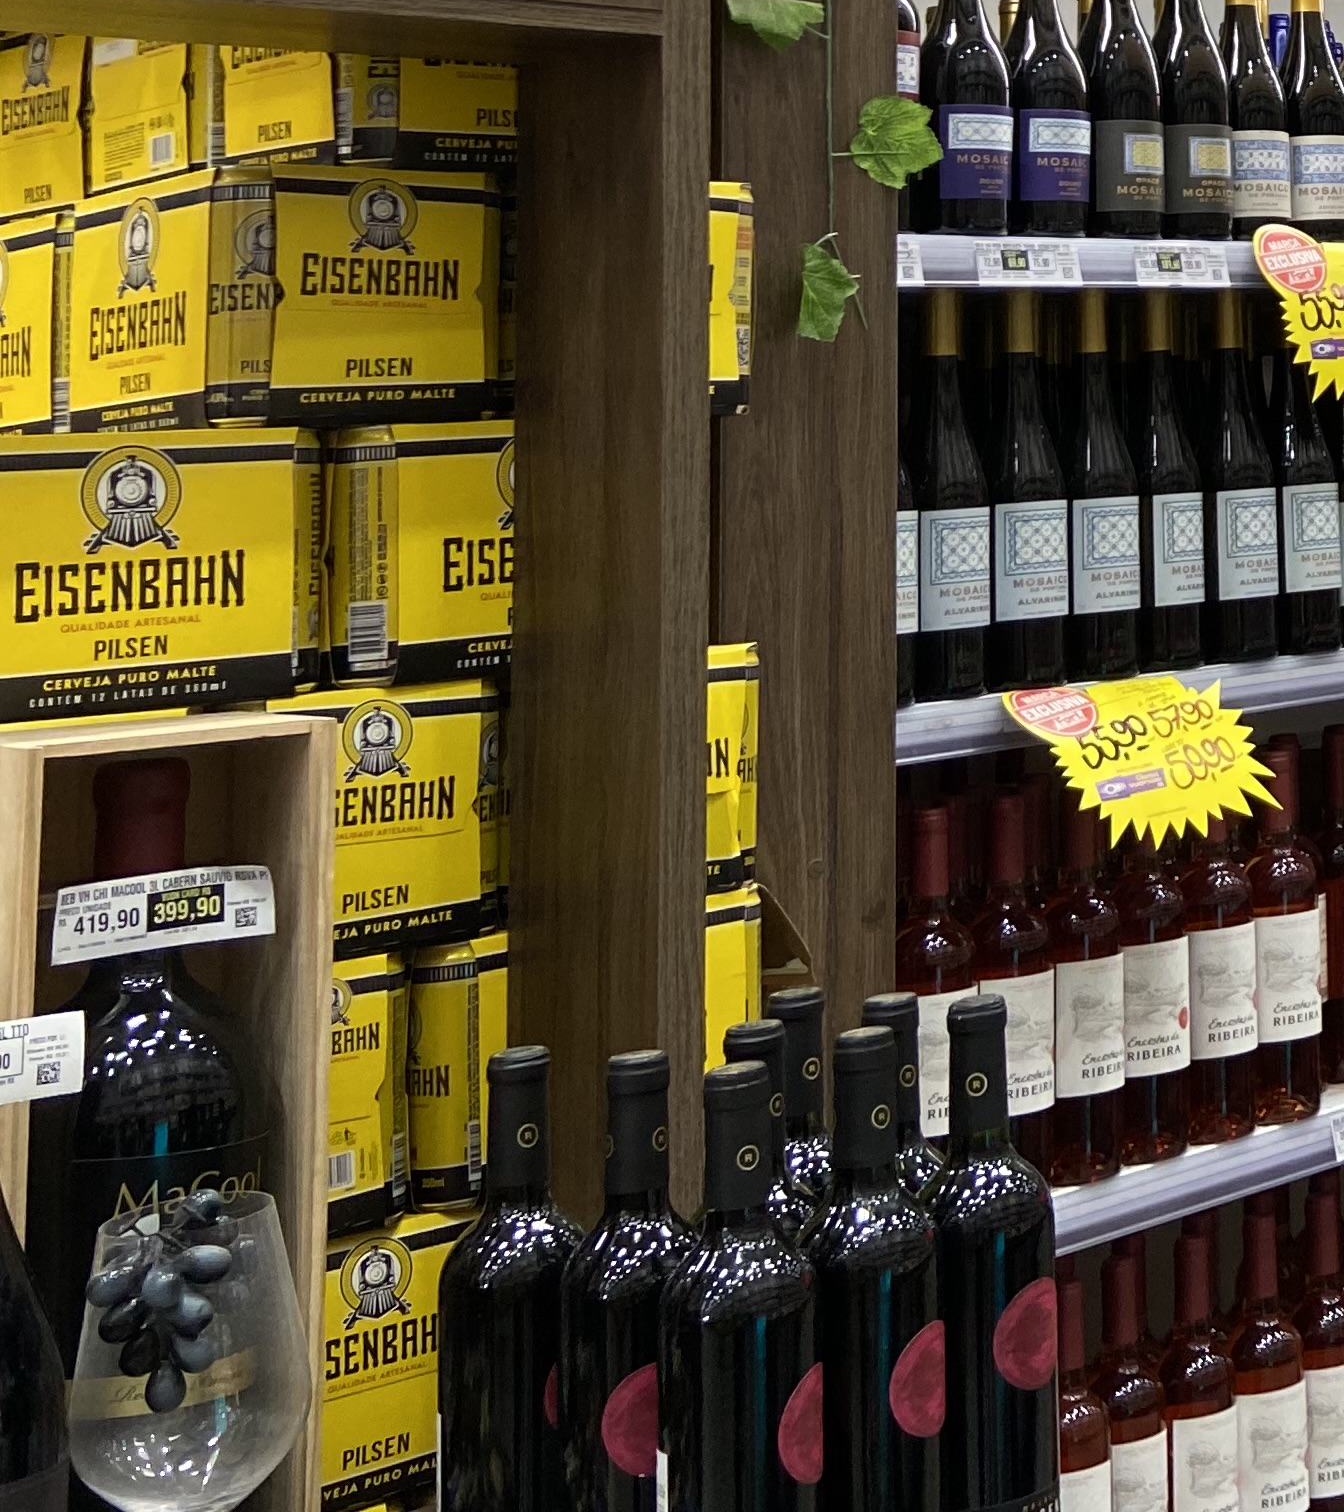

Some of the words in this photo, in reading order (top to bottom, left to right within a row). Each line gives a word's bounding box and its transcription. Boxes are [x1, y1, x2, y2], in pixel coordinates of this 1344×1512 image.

[2, 86, 70, 135] EISENBAHN
[258, 121, 292, 142] PILSEN
[1268, 239, 1300, 250] MARCA
[1264, 249, 1323, 271] EXCLUSIVA
[301, 253, 459, 300] EISENBAHN
[89, 291, 186, 361] EISENBAHN
[345, 358, 413, 378] PILSEN
[120, 373, 150, 394] PILSEN
[301, 390, 362, 403] CERVEJA
[367, 390, 405, 401] PURO
[409, 388, 456, 400] MALTE
[15, 549, 246, 624] EISENBAHN
[60, 620, 131, 634] QUALIDADE
[134, 614, 201, 628] ARTESANAL
[94, 635, 169, 662] PILSEN
[43, 674, 112, 692] CERVEJA
[118, 670, 160, 684] PURO
[166, 666, 217, 680] MALTE
[92, 693, 105, 704] 12
[113, 689, 154, 701] LATAS
[162, 685, 177, 696] DE
[1024, 695, 1088, 722] EXCLUSIVA
[93, 887, 108, 900] CHI
[111, 883, 146, 897] MACOOL
[162, 874, 197, 889] CABERN
[342, 884, 409, 914] PILSEN
[74, 907, 140, 935] 419,90
[154, 895, 221, 924] 399,90
[364, 920, 401, 936] PURO
[408, 910, 453, 926] MALTE
[1208, 1025, 1255, 1044] RIBEIRA
[1127, 1044, 1182, 1062] RIBEIRA
[342, 1433, 410, 1471] PILSEN
[365, 1469, 401, 1488] PURO
